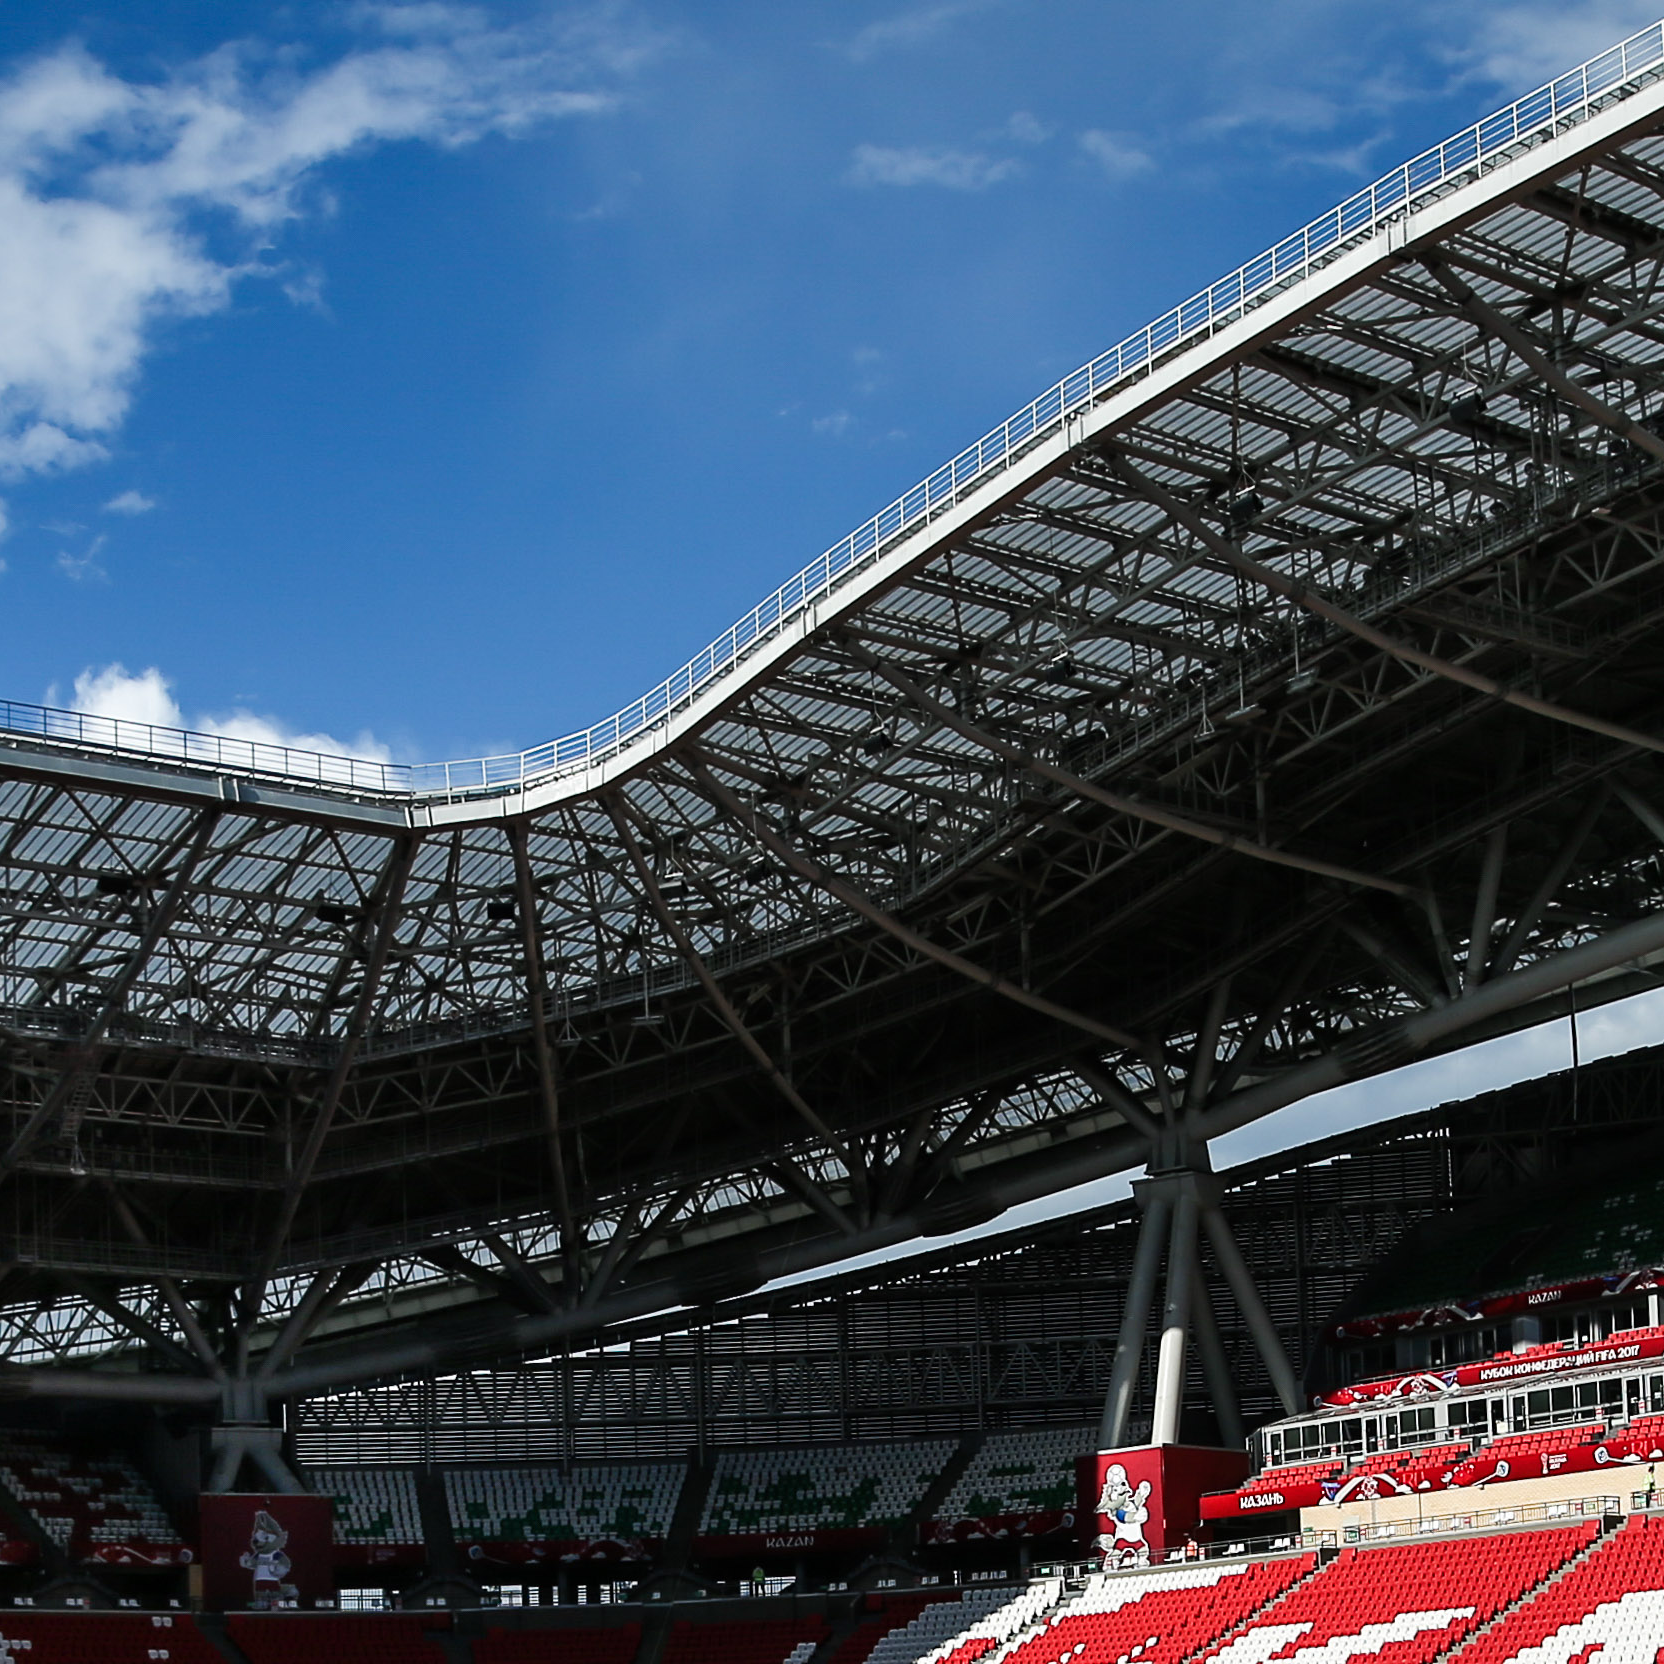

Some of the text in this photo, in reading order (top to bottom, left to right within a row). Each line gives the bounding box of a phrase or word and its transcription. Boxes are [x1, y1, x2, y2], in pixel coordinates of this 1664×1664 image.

[1528, 1290, 1561, 1305] KAZAN
[1481, 1366, 1513, 1380] КУБОК
[1595, 1350, 1616, 1362] FIFA
[1618, 1345, 1640, 1358] 2017
[1240, 1493, 1283, 1509] КАЗАНЬ
[766, 1536, 814, 1548] KAZAN
